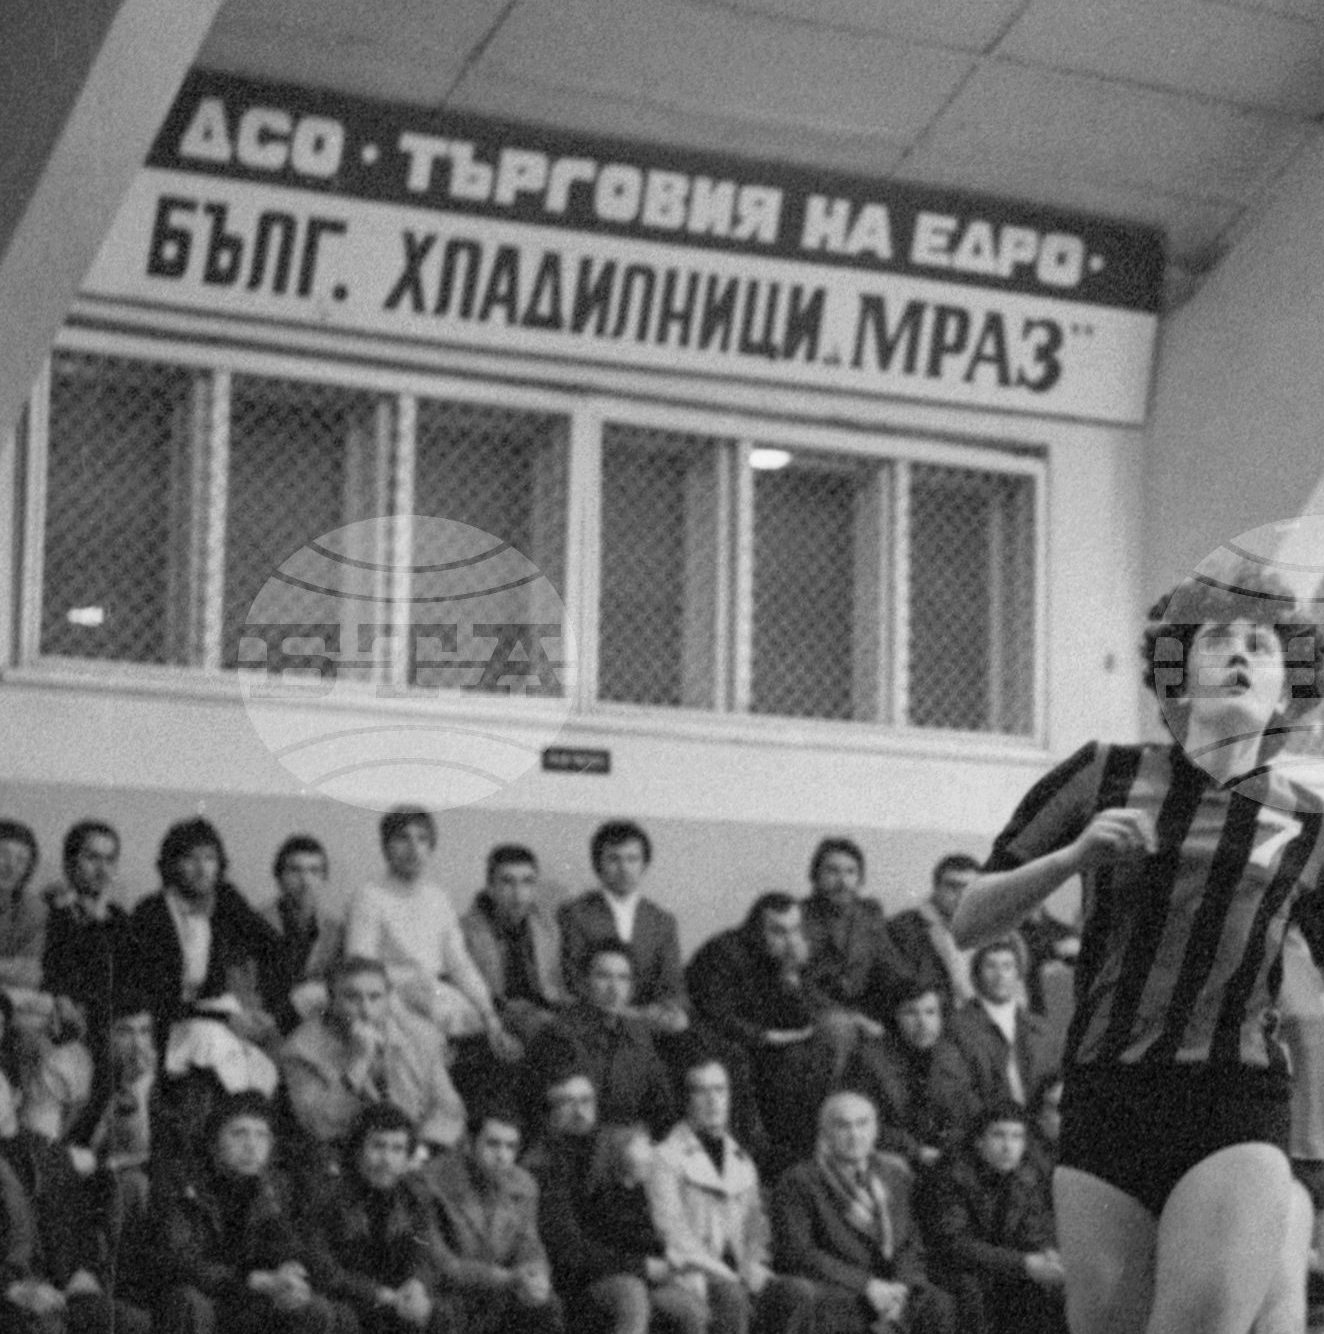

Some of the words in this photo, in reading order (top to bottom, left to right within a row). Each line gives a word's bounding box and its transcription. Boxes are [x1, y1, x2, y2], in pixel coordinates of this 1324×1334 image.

[179, 97, 345, 178] ДСО
[401, 131, 783, 243] ТЪРГОВИЯ
[803, 195, 893, 259] НА
[147, 195, 349, 302] БЪЛГ.
[383, 229, 826, 364] ХЛАДИЛНИЦИ
